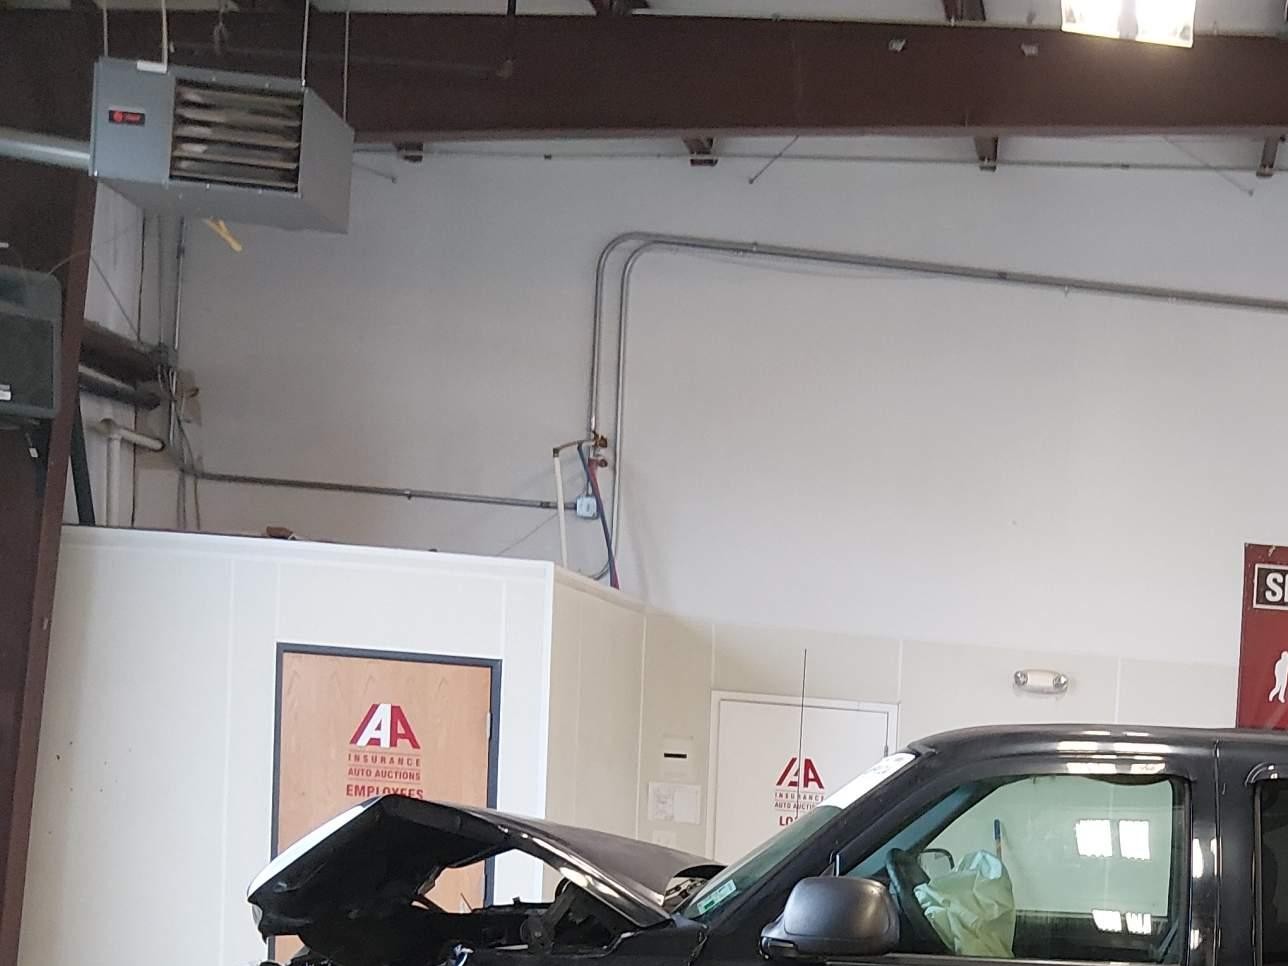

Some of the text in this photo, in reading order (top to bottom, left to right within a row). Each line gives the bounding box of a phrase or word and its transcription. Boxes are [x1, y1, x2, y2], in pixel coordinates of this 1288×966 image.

[348, 753, 420, 766] INSURANCE
[348, 767, 421, 781] AUTO AUCTIONS
